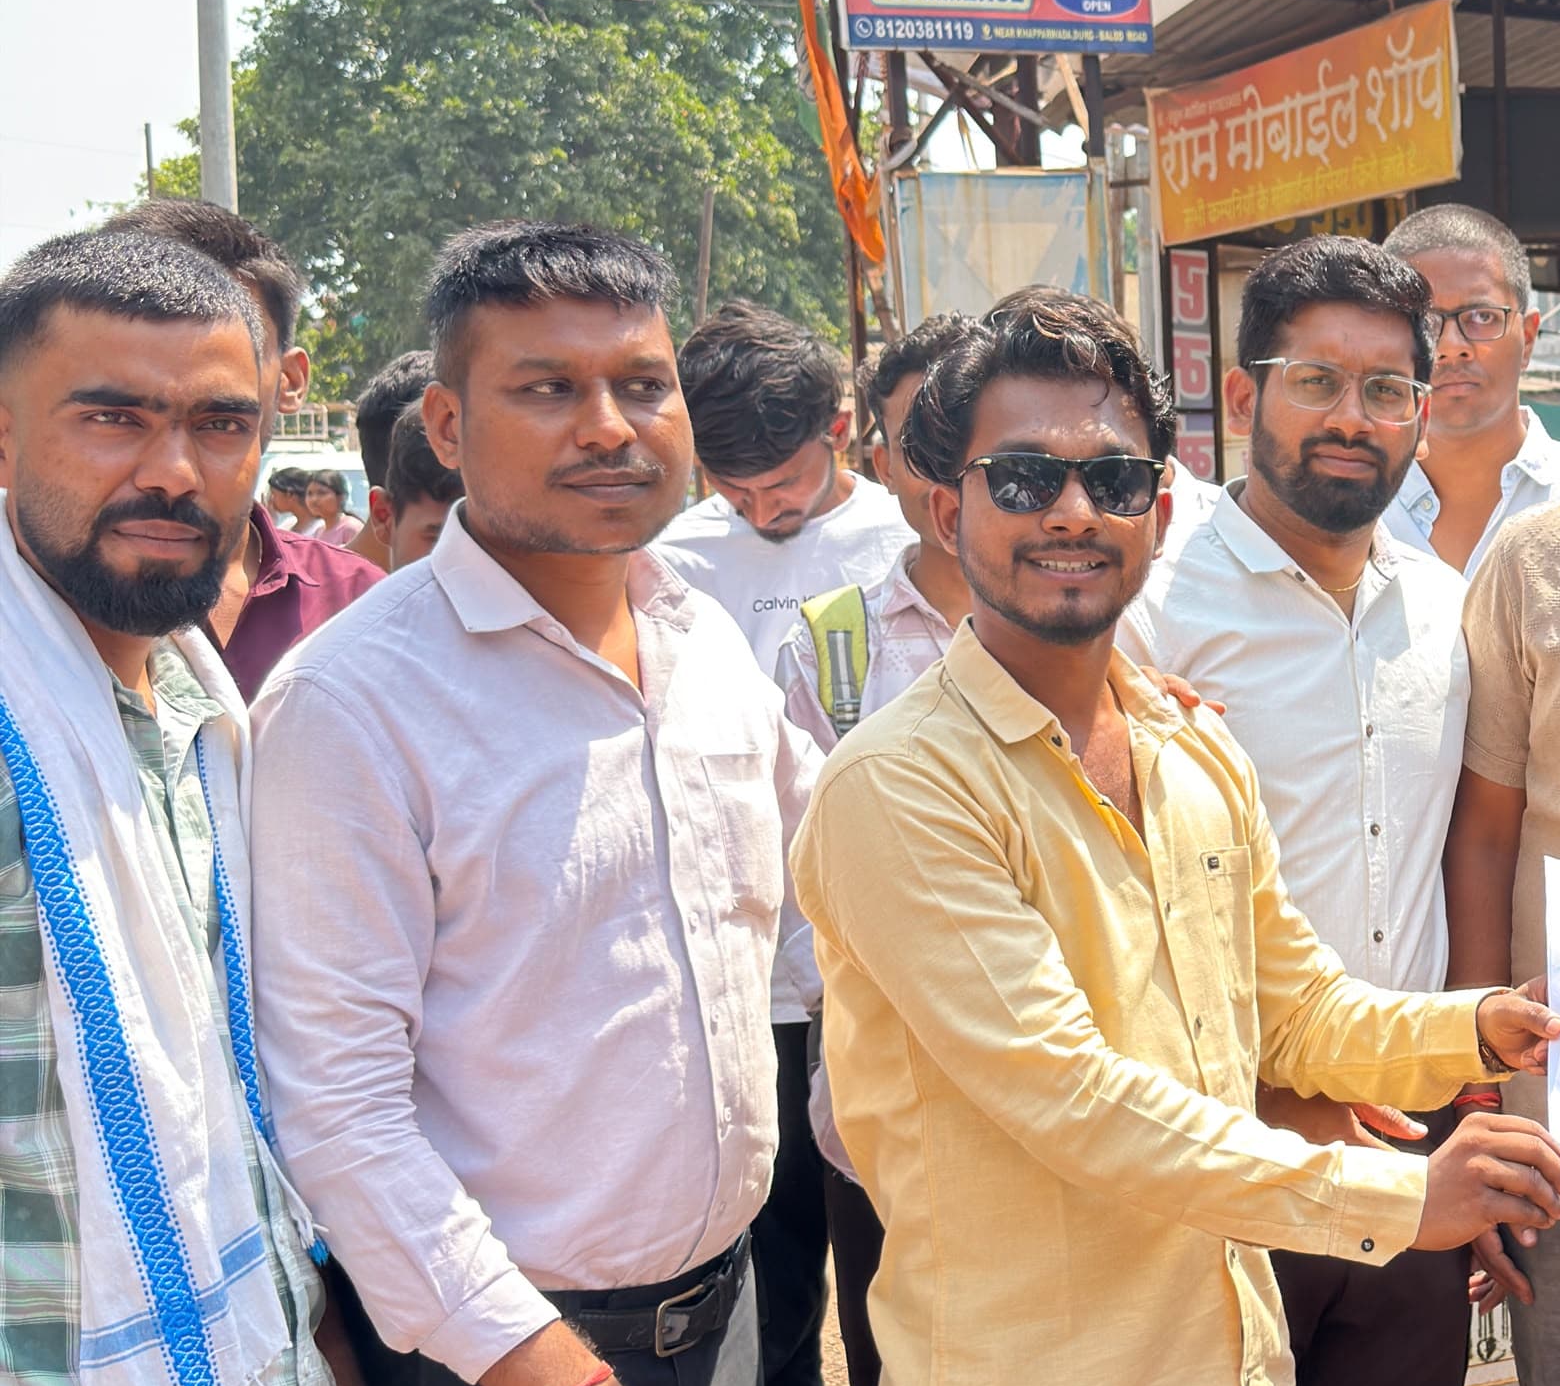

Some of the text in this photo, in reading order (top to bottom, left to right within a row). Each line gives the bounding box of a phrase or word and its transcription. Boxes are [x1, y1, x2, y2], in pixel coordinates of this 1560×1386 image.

[1082, 0, 1111, 12] OPEN
[875, 19, 974, 41] 8120381119
[993, 25, 1015, 38] NEAR
[1160, 27, 1444, 195] राम मोबाईल शॉप
[752, 595, 799, 613] Calvin
